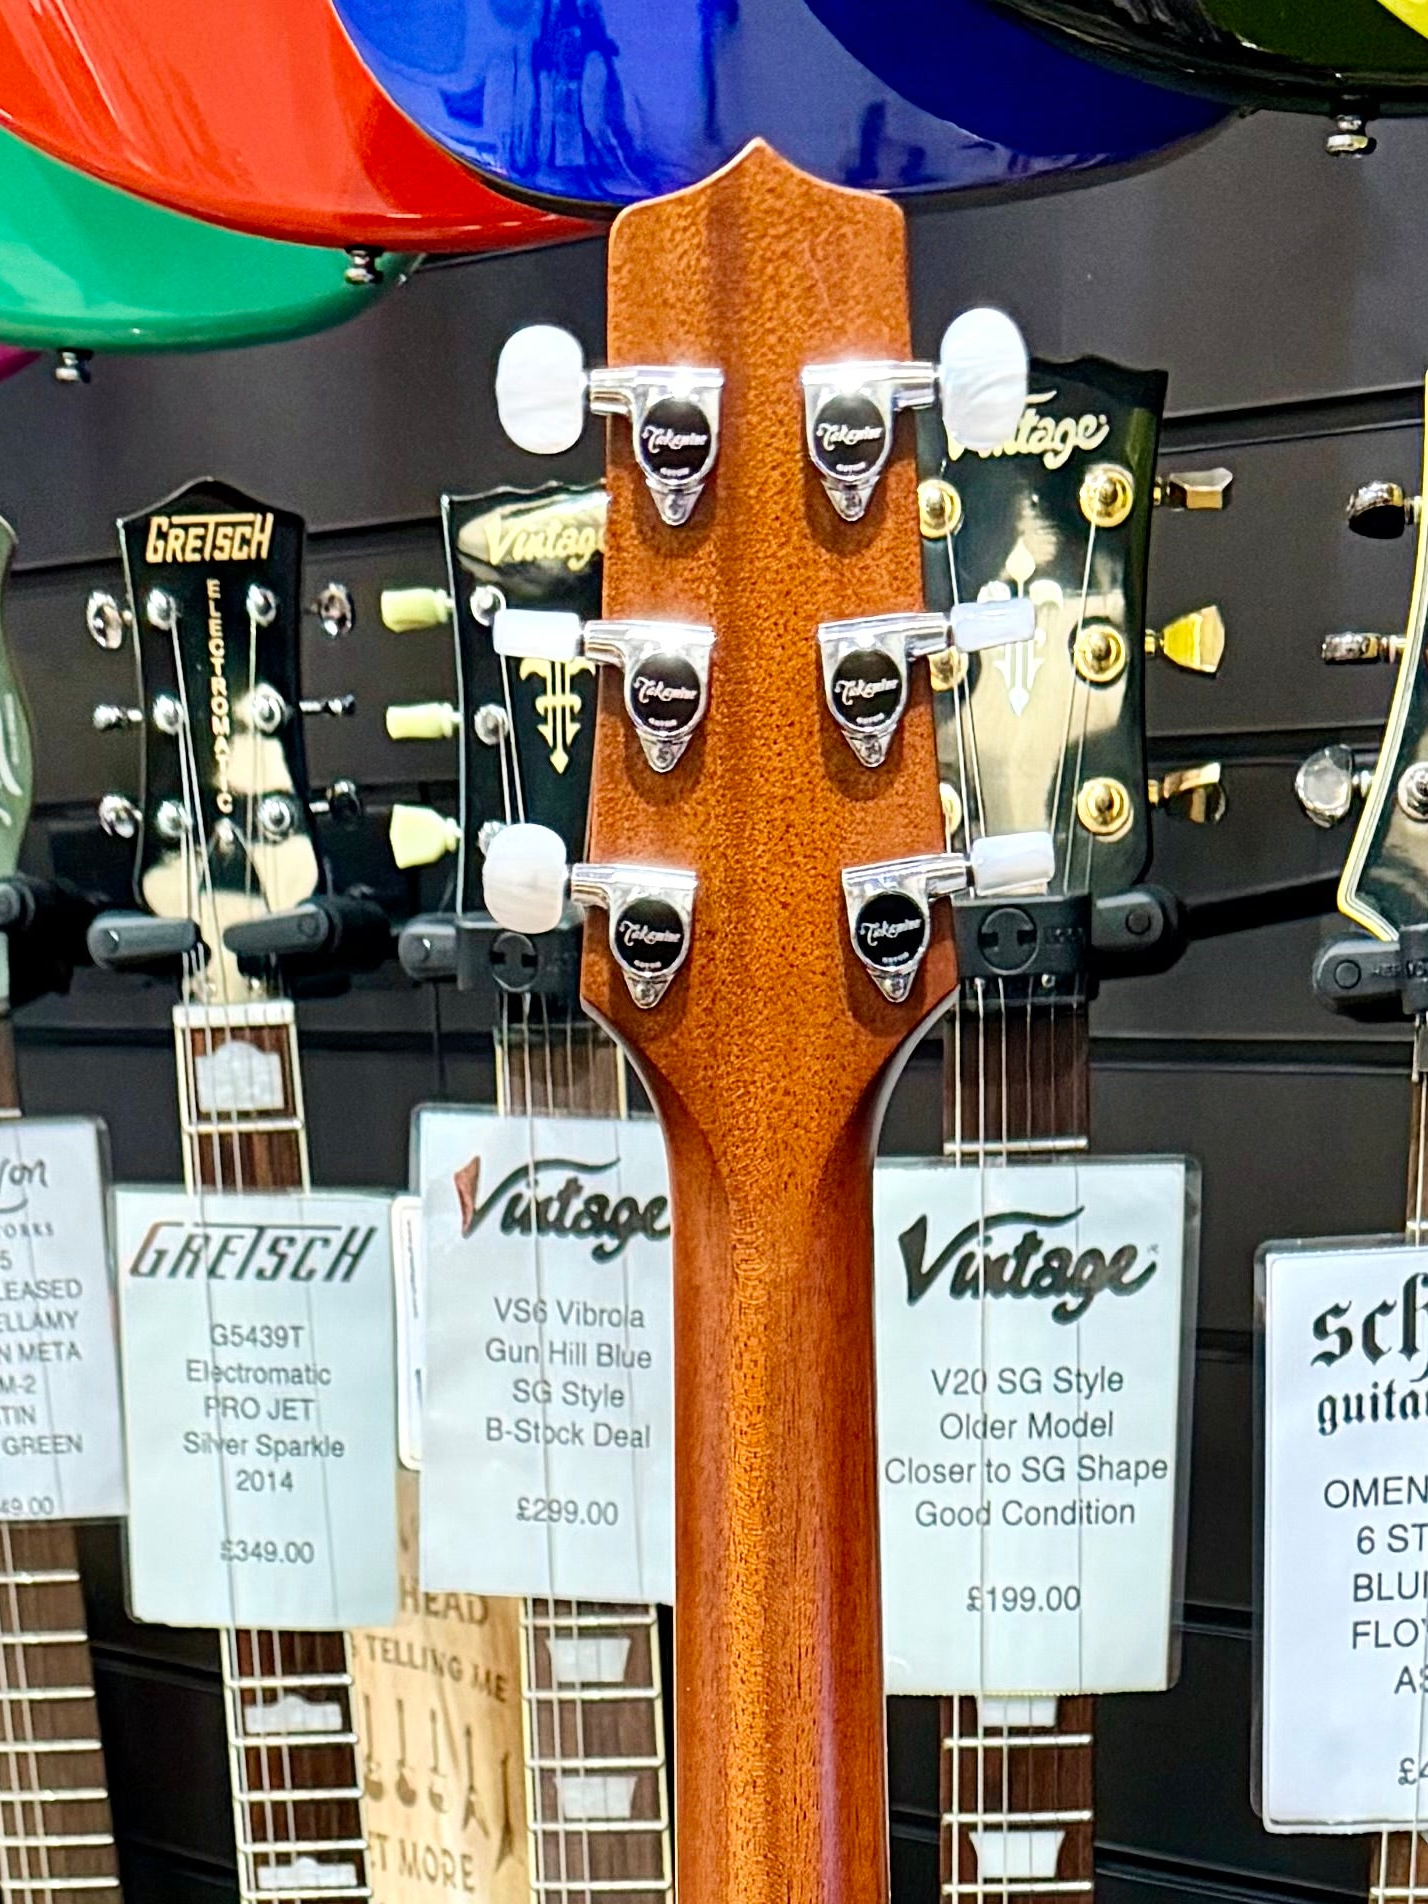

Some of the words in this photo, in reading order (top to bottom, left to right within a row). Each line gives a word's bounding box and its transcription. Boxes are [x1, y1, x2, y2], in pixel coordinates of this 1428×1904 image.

[145, 512, 274, 564] GRETSCH
[206, 578, 233, 814] ELECTROMATIC
[453, 1154, 671, 1266] Vintage
[128, 1220, 380, 1284] GRETSCH
[897, 1204, 1158, 1327] Vintage
[493, 1296, 549, 1325] VS6
[555, 1299, 646, 1329] Vibrola
[17, 1340, 84, 1364] META
[209, 1323, 306, 1351] G5439T
[484, 1336, 540, 1365] Gun
[548, 1340, 588, 1369] Hill
[595, 1342, 653, 1370] Blue
[184, 1358, 334, 1387] Electromatic
[930, 1367, 988, 1397] V20
[996, 1366, 1043, 1396] SG
[1052, 1365, 1125, 1401] Style
[203, 1395, 262, 1421] PRO
[266, 1397, 315, 1422] JET
[511, 1378, 553, 1405] SG
[560, 1380, 627, 1414] Style
[484, 1416, 586, 1448] B-Stock
[592, 1421, 652, 1450] Deal
[939, 1410, 1019, 1441] Older
[1027, 1409, 1115, 1440] Model
[0, 1432, 86, 1458] GREEN
[182, 1430, 250, 1458] Silver
[254, 1432, 347, 1462] Sparkle
[235, 1468, 295, 1494] 2014
[883, 1456, 977, 1486] Closer
[984, 1457, 1012, 1485] to
[1020, 1455, 1067, 1484] SG
[1076, 1453, 1170, 1489] Shape
[515, 1496, 620, 1527] £299.00
[914, 1499, 992, 1529] Good
[1001, 1498, 1136, 1528] Condition
[218, 1538, 317, 1566] £349.00
[1356, 1524, 1376, 1556] 6
[965, 1584, 1083, 1614] £199.00
[364, 1634, 464, 1682] TELLING
[398, 1838, 475, 1892] MORE
